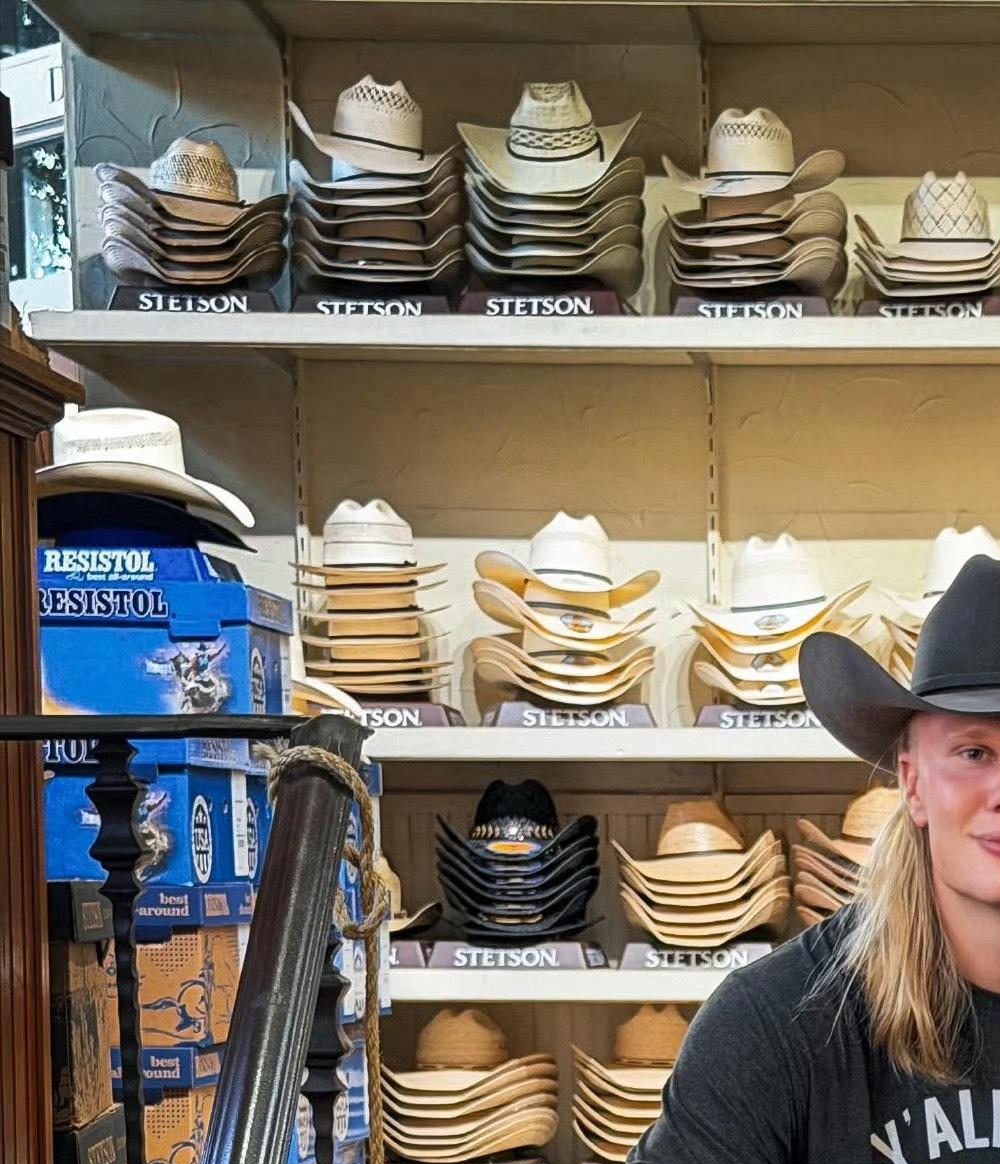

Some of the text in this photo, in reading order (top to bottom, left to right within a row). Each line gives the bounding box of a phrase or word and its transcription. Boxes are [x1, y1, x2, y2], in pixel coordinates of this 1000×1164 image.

[138, 293, 248, 313] STETSON
[316, 300, 422, 316] STETSON
[486, 296, 594, 316] STETSON
[697, 302, 803, 318] STETSON
[878, 302, 983, 318] STETSON
[43, 549, 155, 573] RESISTOL
[355, 708, 423, 727] TSON
[522, 708, 629, 727] STETSON
[159, 892, 189, 905] best
[453, 947, 560, 967] STETSON
[645, 950, 750, 968] STETSON
[150, 1055, 180, 1068] best
